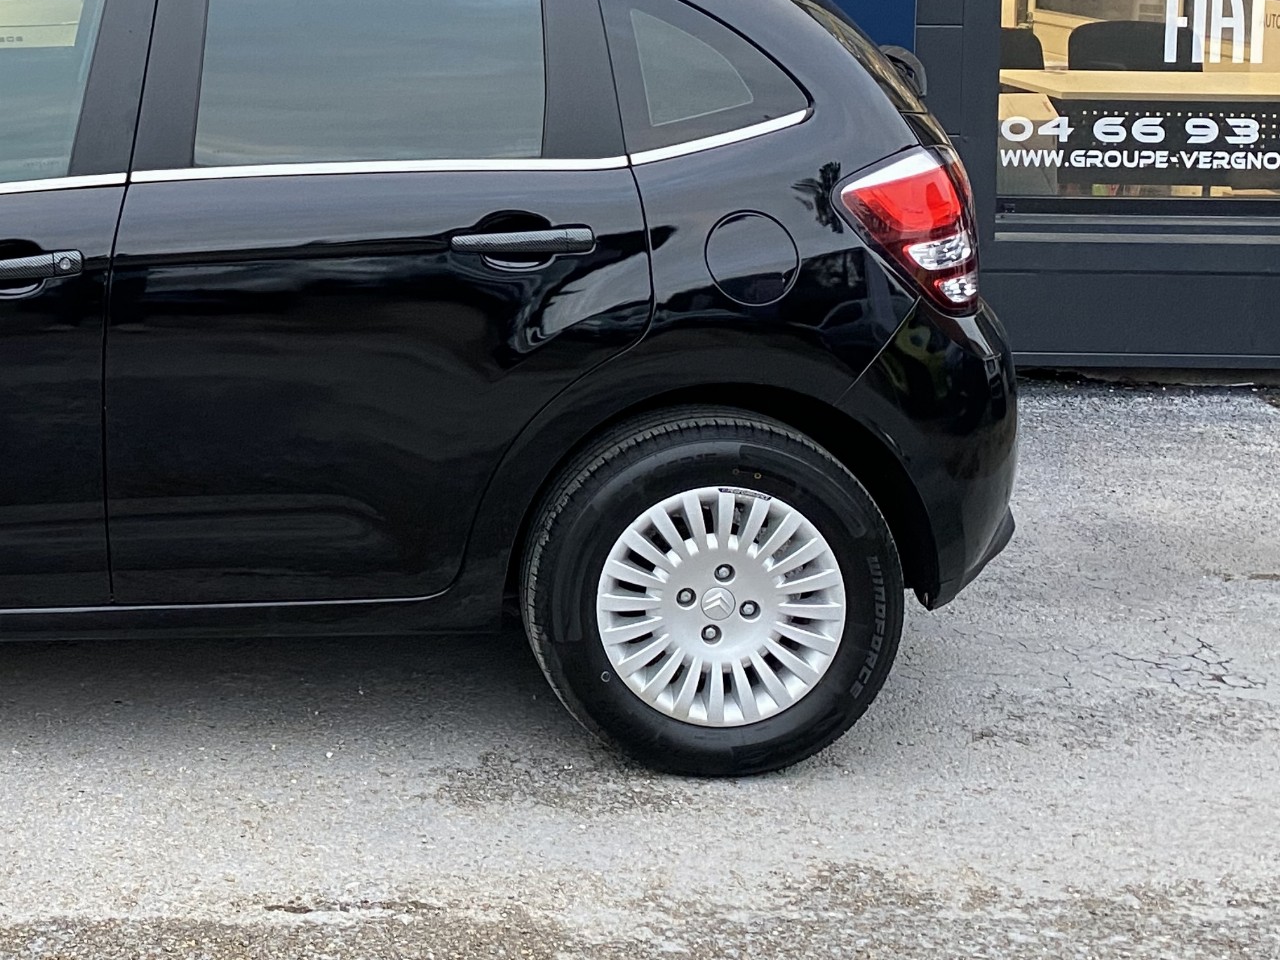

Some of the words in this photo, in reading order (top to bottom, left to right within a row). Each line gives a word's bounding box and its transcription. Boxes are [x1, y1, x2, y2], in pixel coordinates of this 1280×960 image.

[1000, 116, 1075, 143] 04
[1092, 117, 1166, 143] 66
[1184, 118, 1261, 145] 93
[1000, 149, 1280, 170] WWW.GROUPE-VERGNO
